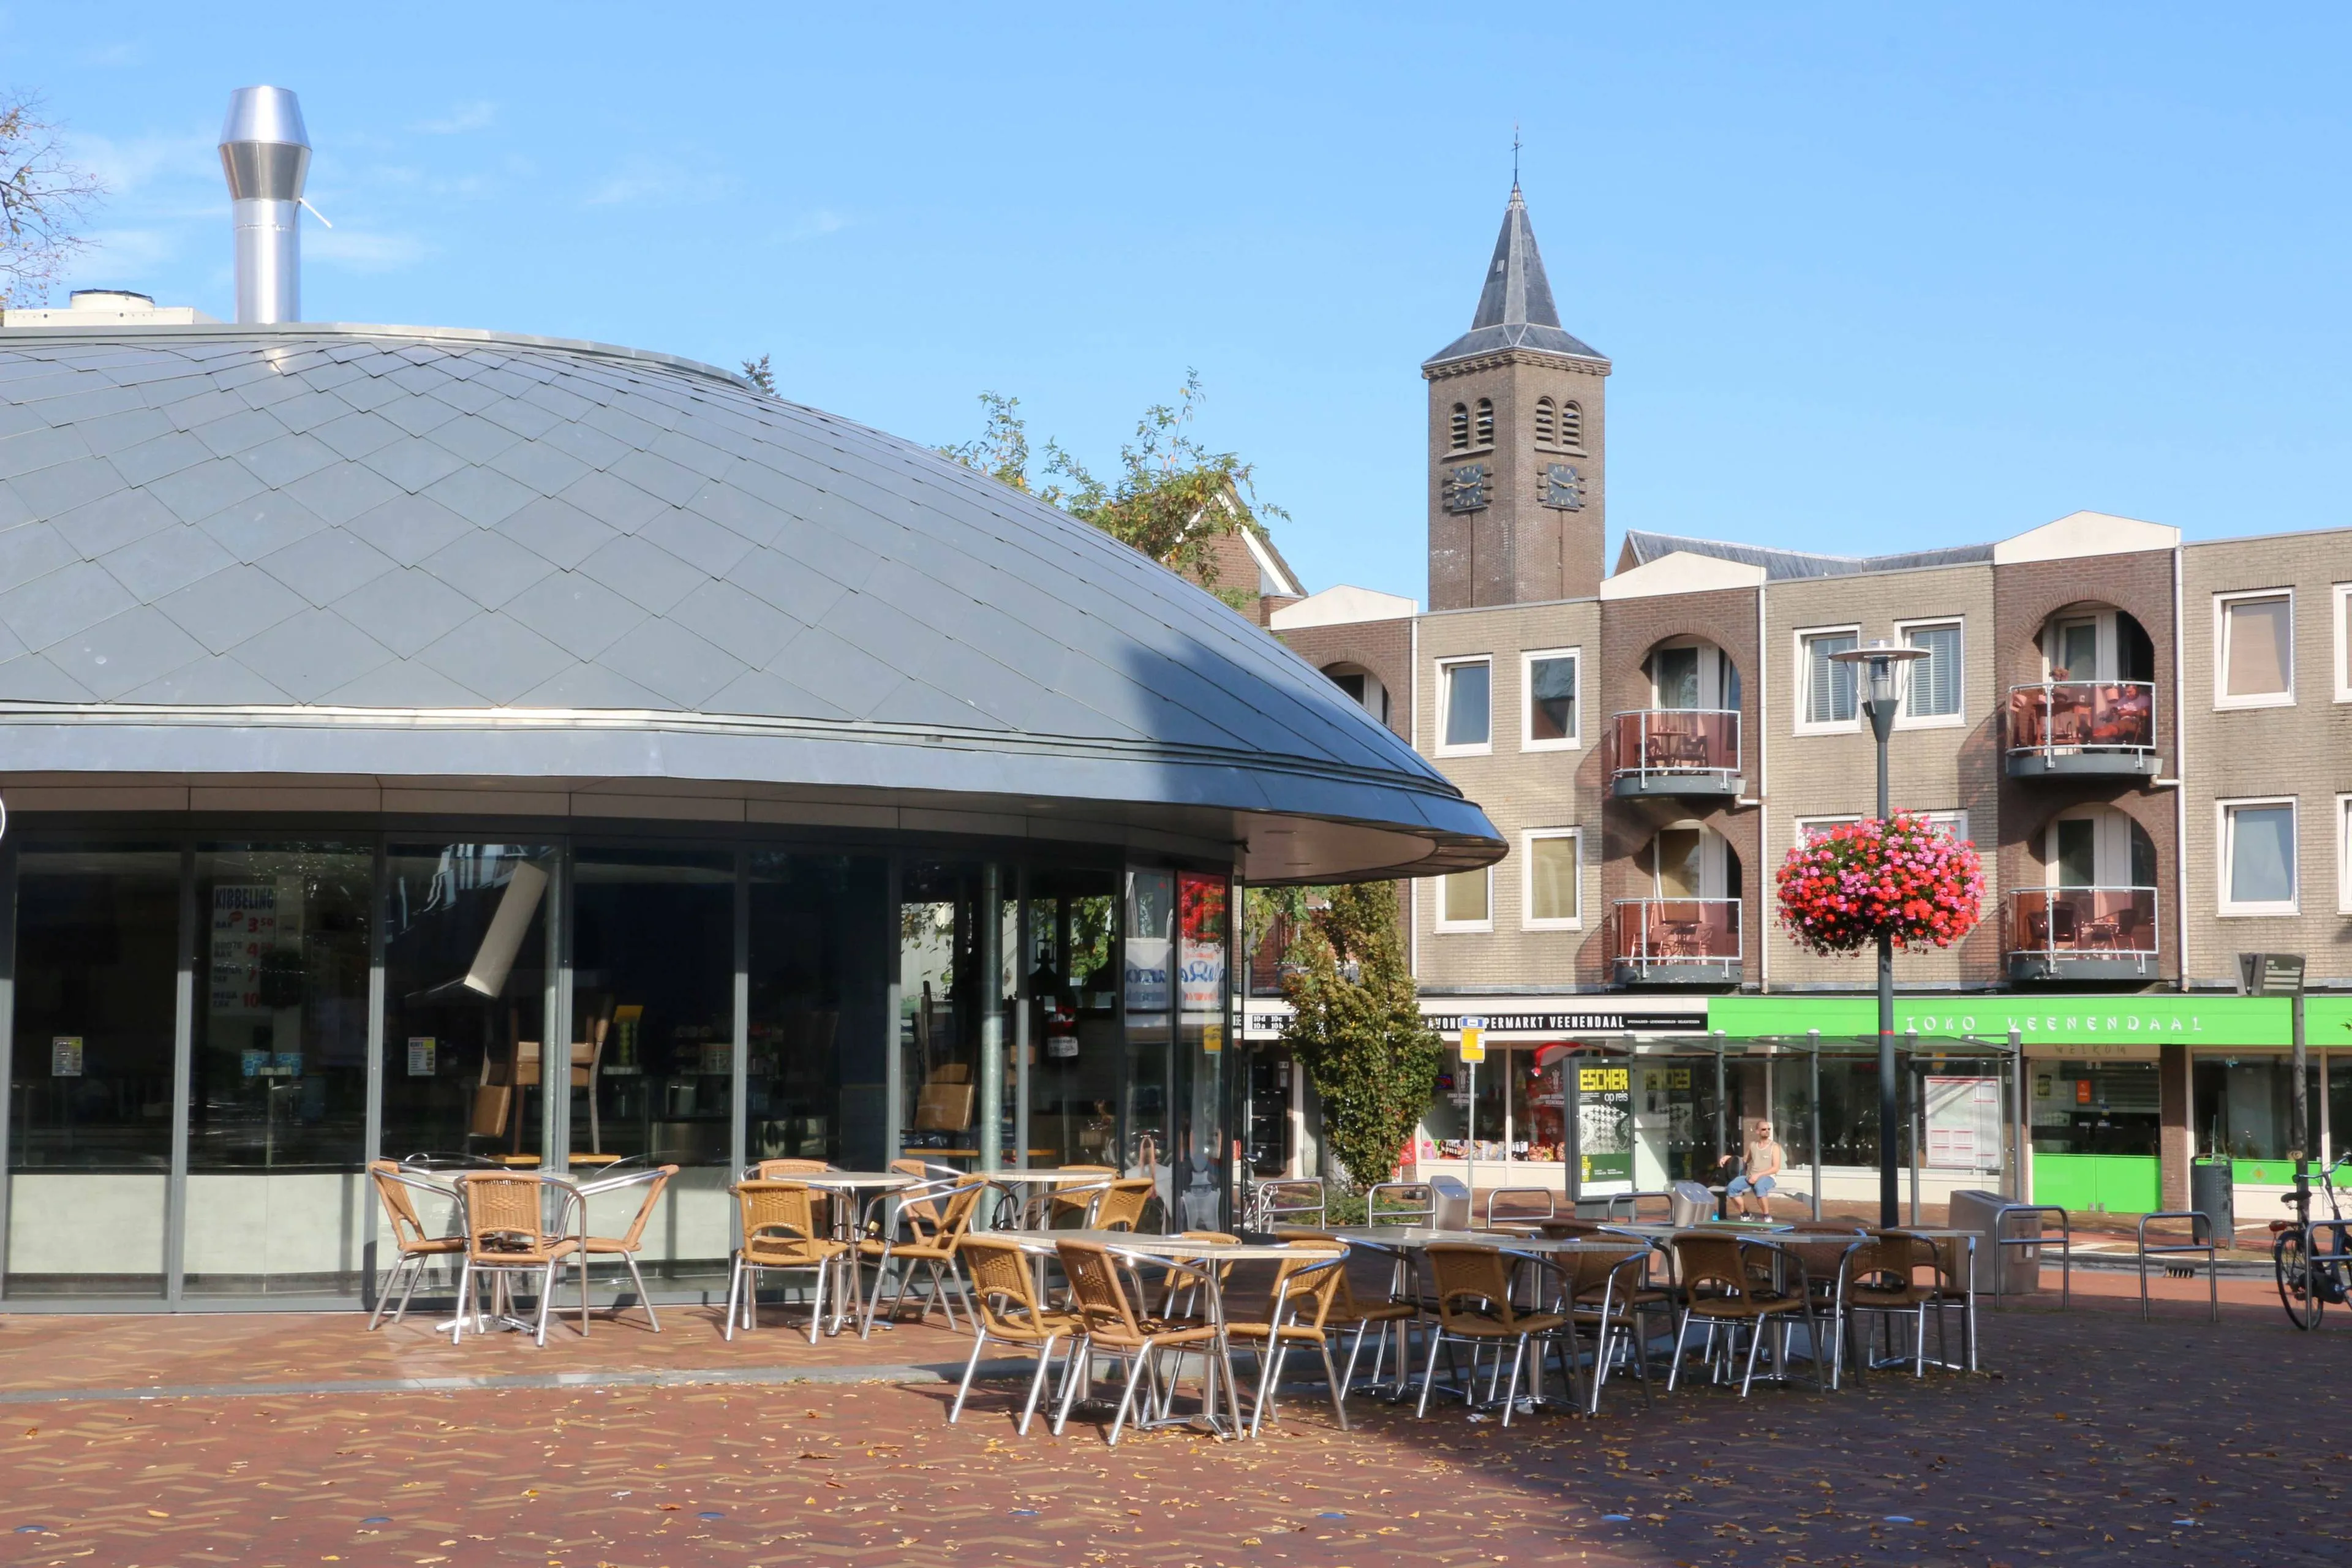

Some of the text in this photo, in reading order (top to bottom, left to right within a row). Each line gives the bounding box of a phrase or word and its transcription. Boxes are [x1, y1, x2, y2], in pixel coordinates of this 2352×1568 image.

[215, 888, 274, 910] KIBBELING
[1550, 1016, 1624, 1028] VEENENDAAL
[1907, 1016, 2202, 1031] TOKO VEENENDAAL
[1580, 1069, 1628, 1090] ESCHER
[1604, 1093, 1615, 1104] op
[1615, 1090, 1629, 1101] reis
